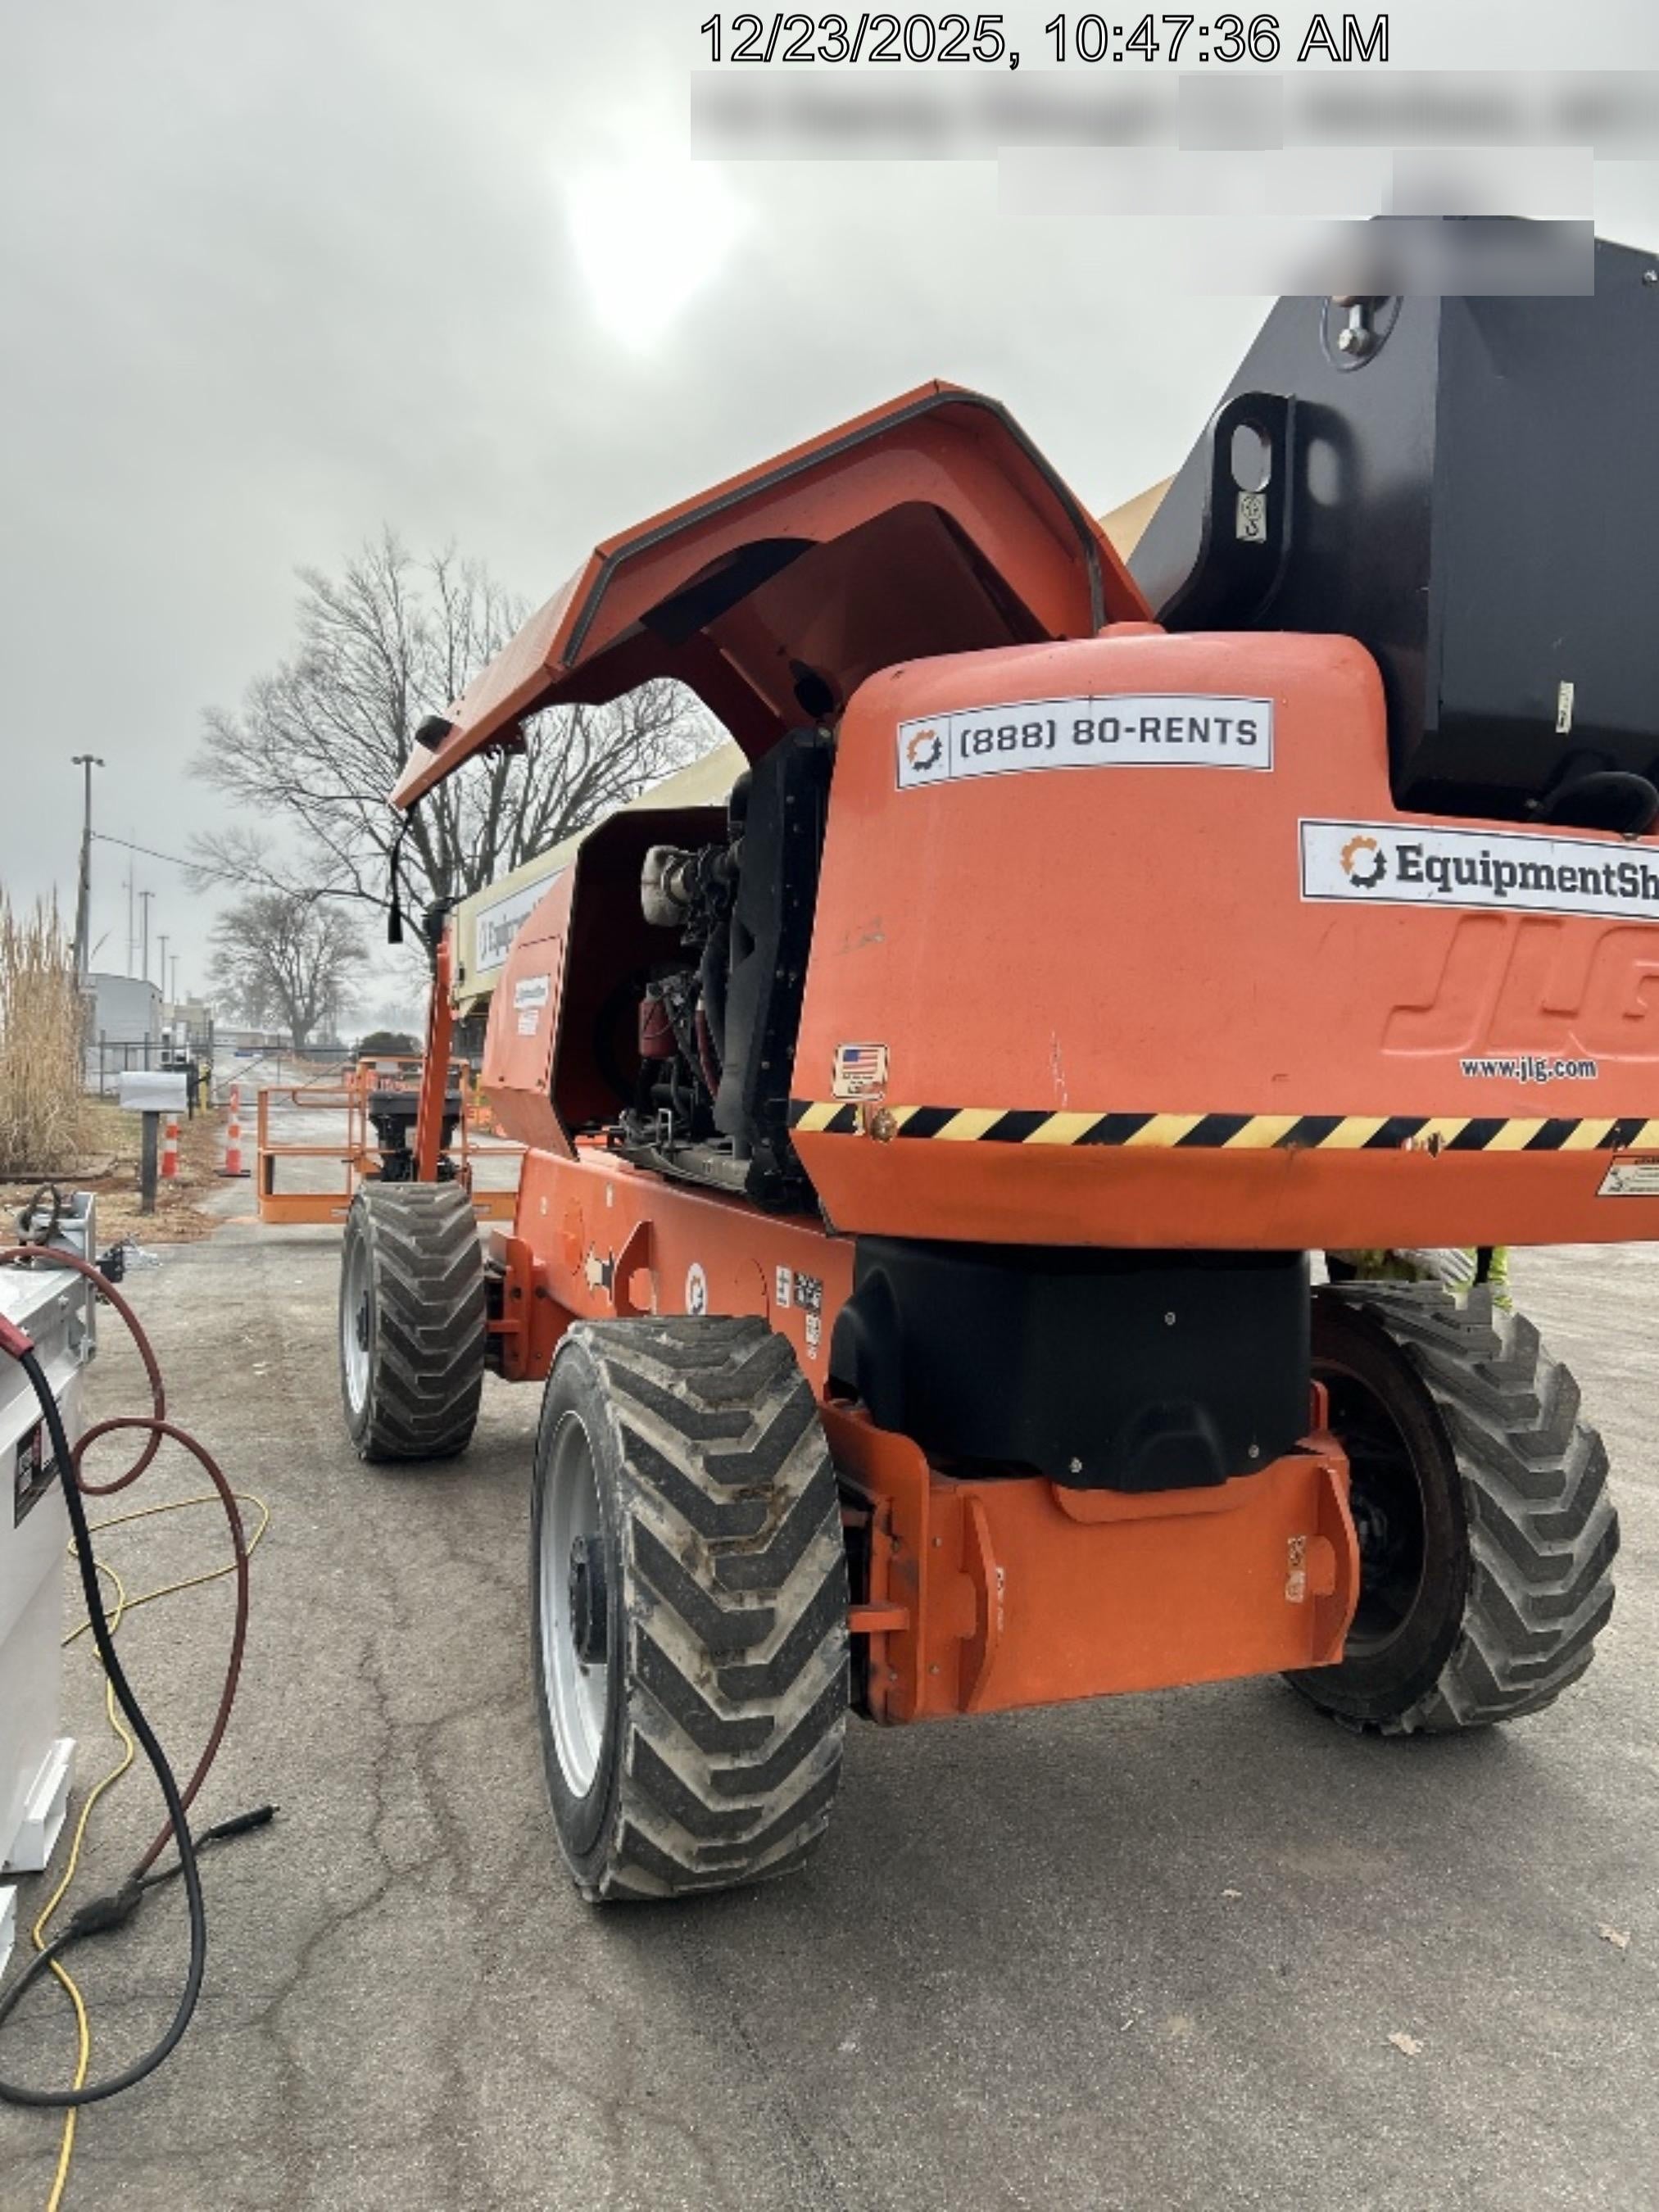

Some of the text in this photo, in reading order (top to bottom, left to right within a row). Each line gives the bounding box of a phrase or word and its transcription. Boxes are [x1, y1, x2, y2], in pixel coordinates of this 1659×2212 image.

[961, 717, 1258, 758] (888) 80-RENTS
[1461, 1056, 1597, 1082] www.jlg.com
